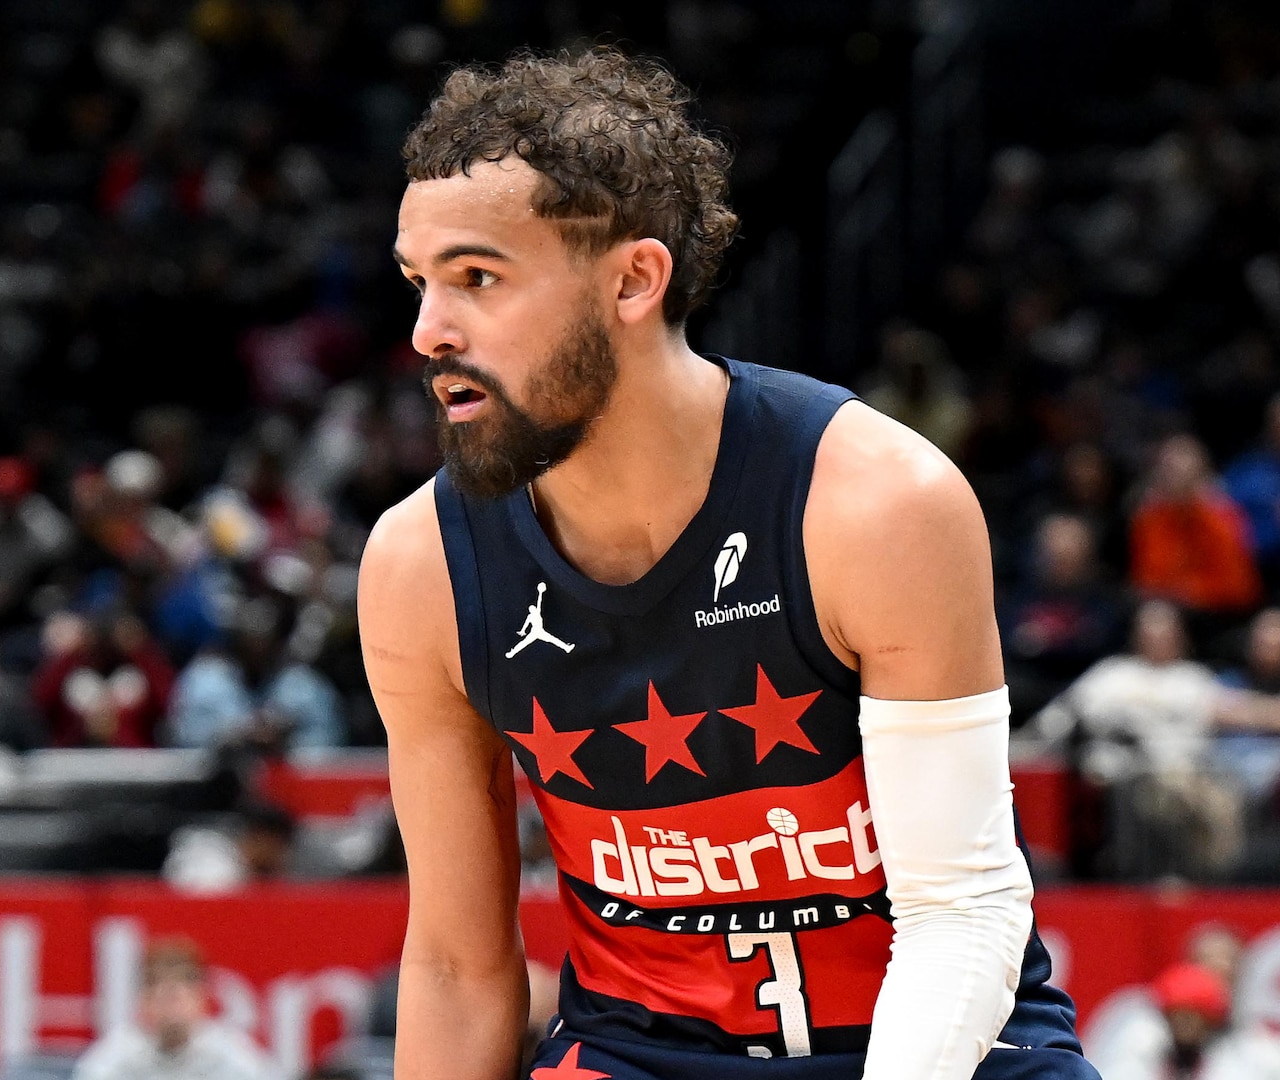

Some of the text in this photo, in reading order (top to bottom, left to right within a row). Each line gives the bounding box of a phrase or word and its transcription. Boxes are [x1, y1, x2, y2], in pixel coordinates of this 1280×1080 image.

[694, 593, 781, 628] Robinhood
[590, 800, 883, 897] district
[642, 826, 691, 846] THE
[600, 902, 872, 932] OF COLUMB
[727, 932, 812, 1059] 3
